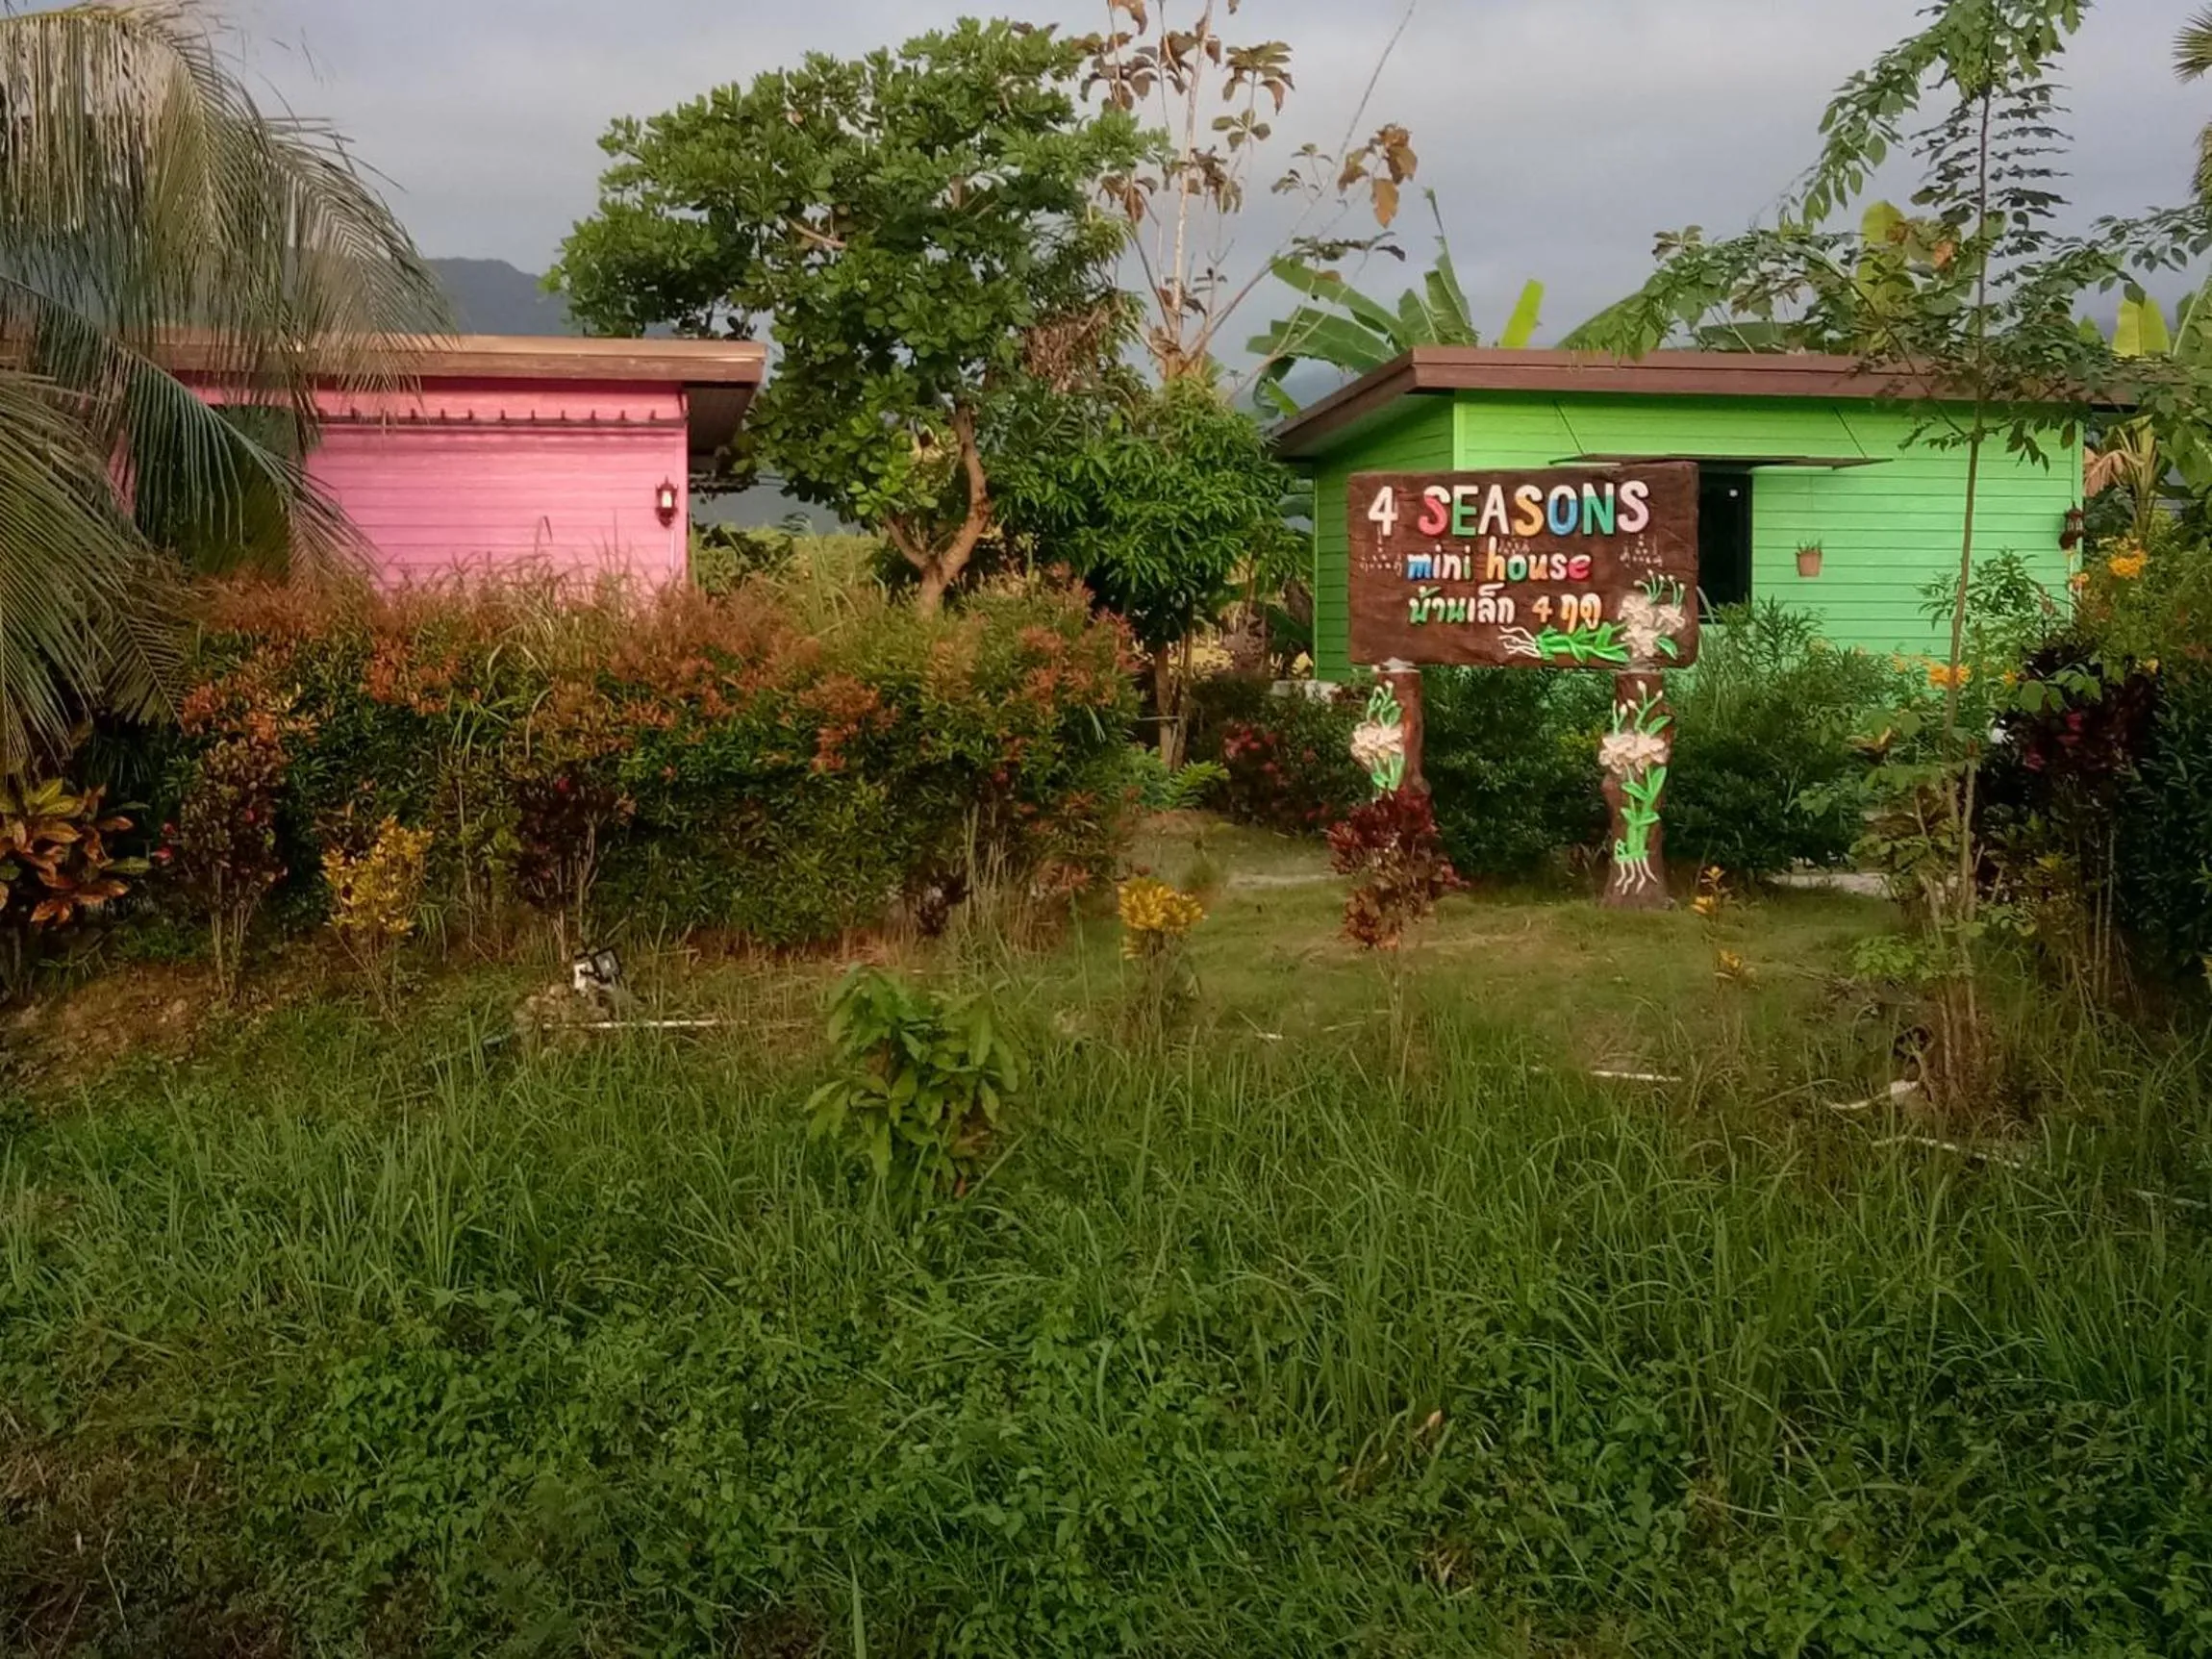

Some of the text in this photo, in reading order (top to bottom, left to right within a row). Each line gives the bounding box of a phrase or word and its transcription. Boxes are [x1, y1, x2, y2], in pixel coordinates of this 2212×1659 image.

[1368, 480, 1650, 538] 4 SEASONS
[1407, 537, 1593, 583] mini house
[1408, 583, 1516, 624] บ้านเล็ก
[1532, 594, 1554, 623] 4
